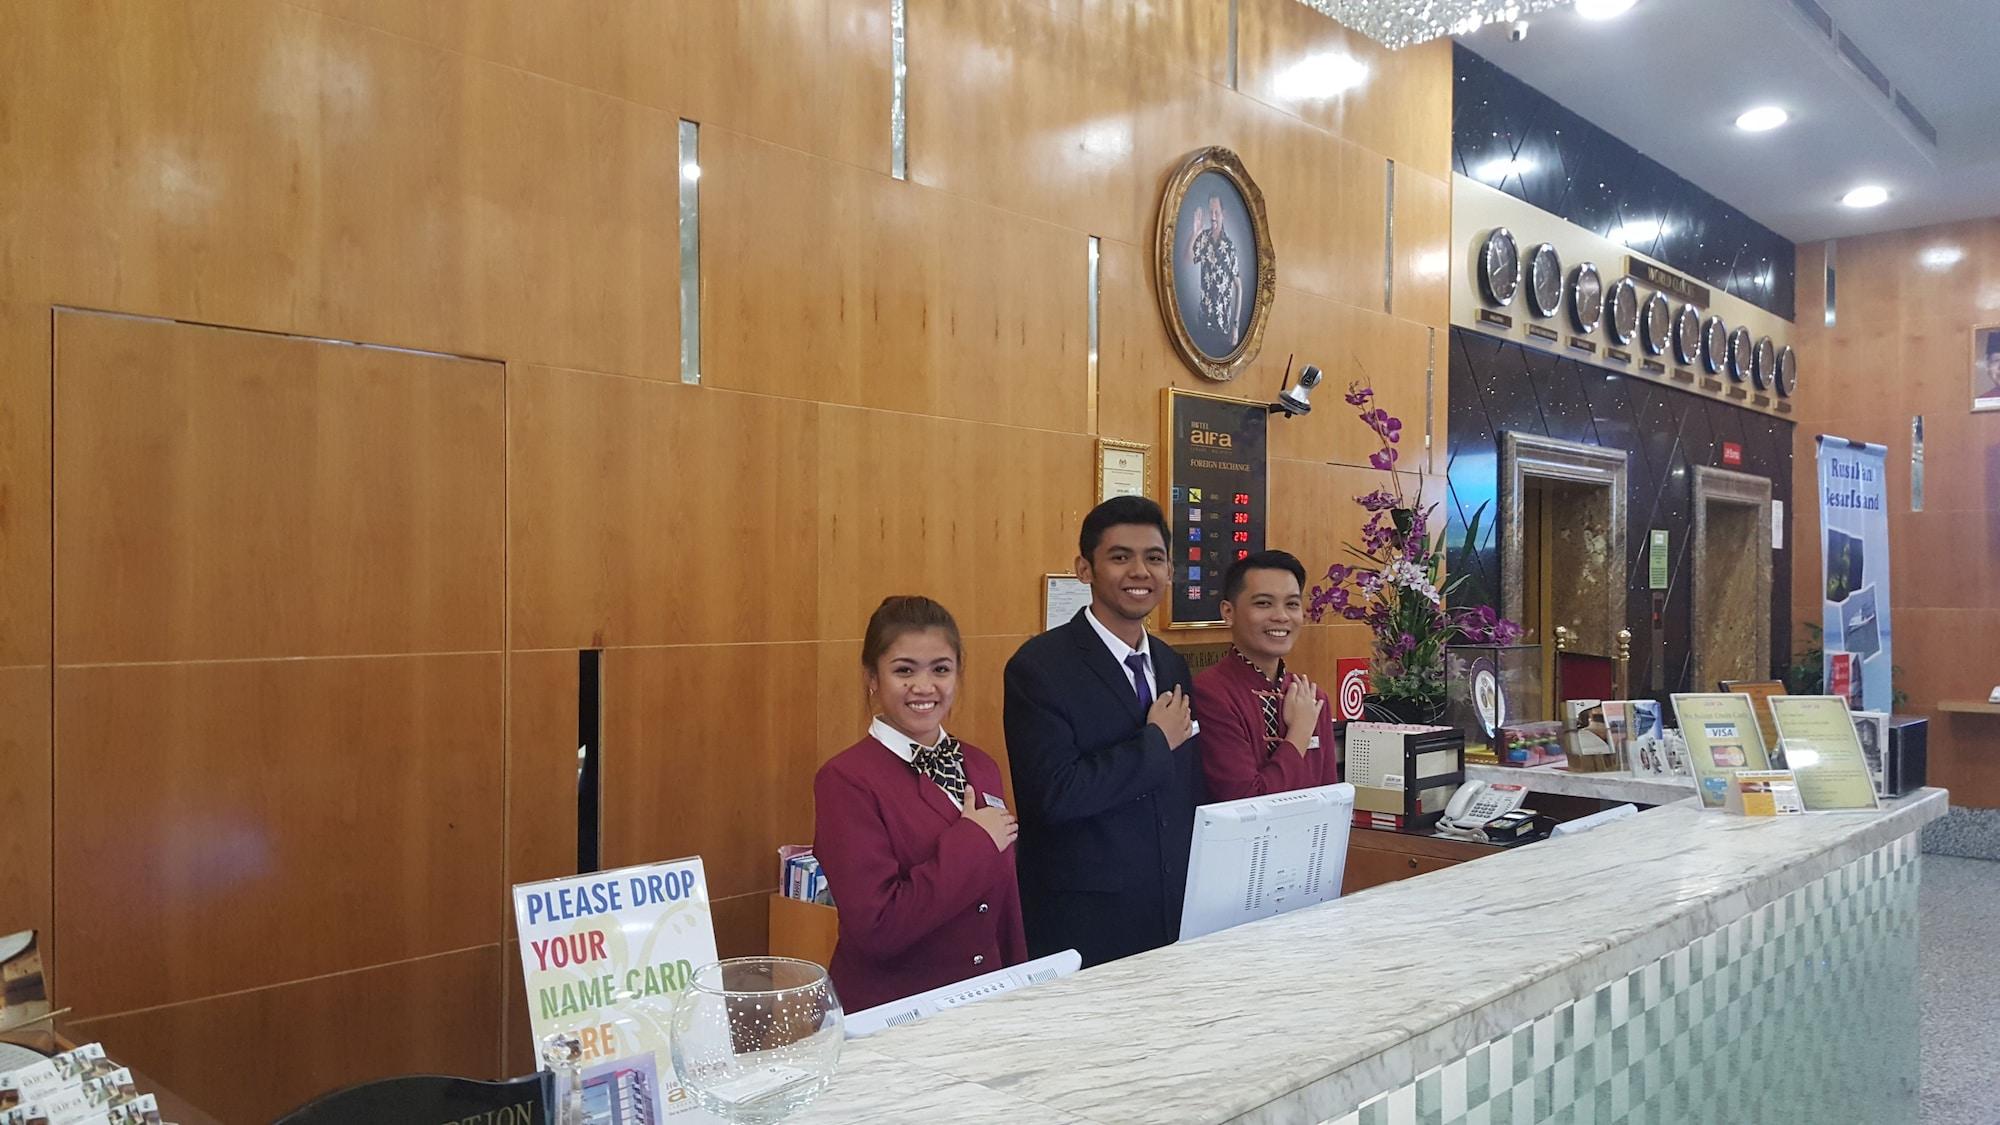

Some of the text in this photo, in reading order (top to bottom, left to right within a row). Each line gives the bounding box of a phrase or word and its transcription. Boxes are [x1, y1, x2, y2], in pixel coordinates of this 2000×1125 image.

[1190, 458, 1252, 472] FOREIGN EXCHANGE
[1234, 493, 1249, 505] 270
[1850, 489, 1880, 510] Isand
[1233, 531, 1248, 542] 270
[1712, 728, 1734, 737] VISA
[527, 869, 695, 925] PLEASE DROP
[531, 930, 607, 971] YOUR
[539, 959, 693, 1020] NAME CARD
